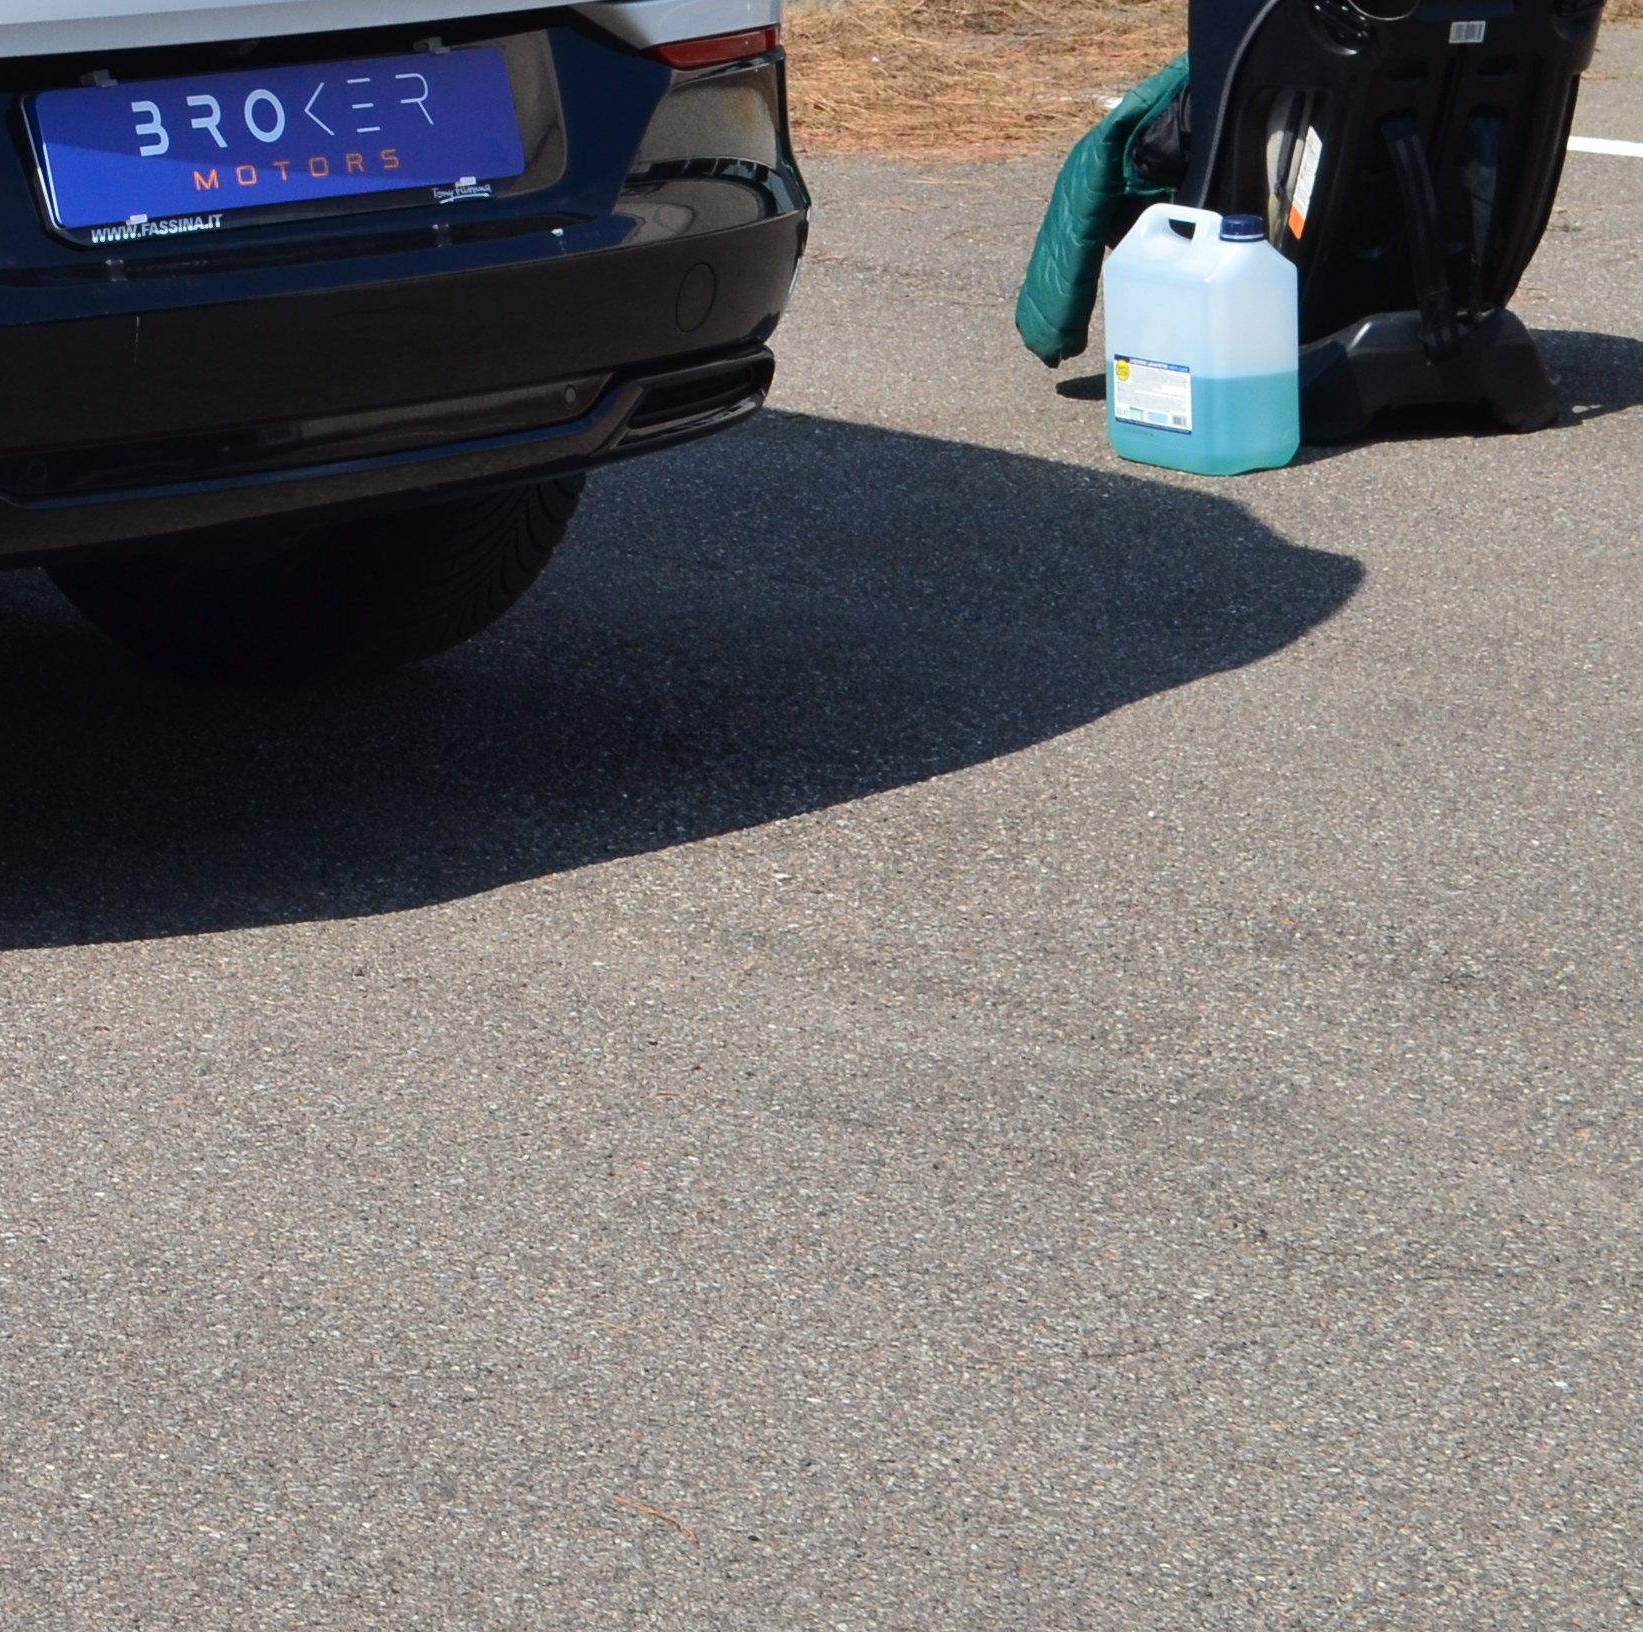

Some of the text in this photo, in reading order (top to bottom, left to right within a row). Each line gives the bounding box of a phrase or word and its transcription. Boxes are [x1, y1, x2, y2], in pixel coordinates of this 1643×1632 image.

[130, 72, 435, 158] BROKER
[193, 148, 402, 192] MOTORS
[89, 213, 224, 244] WWW.FASSINA.IT
